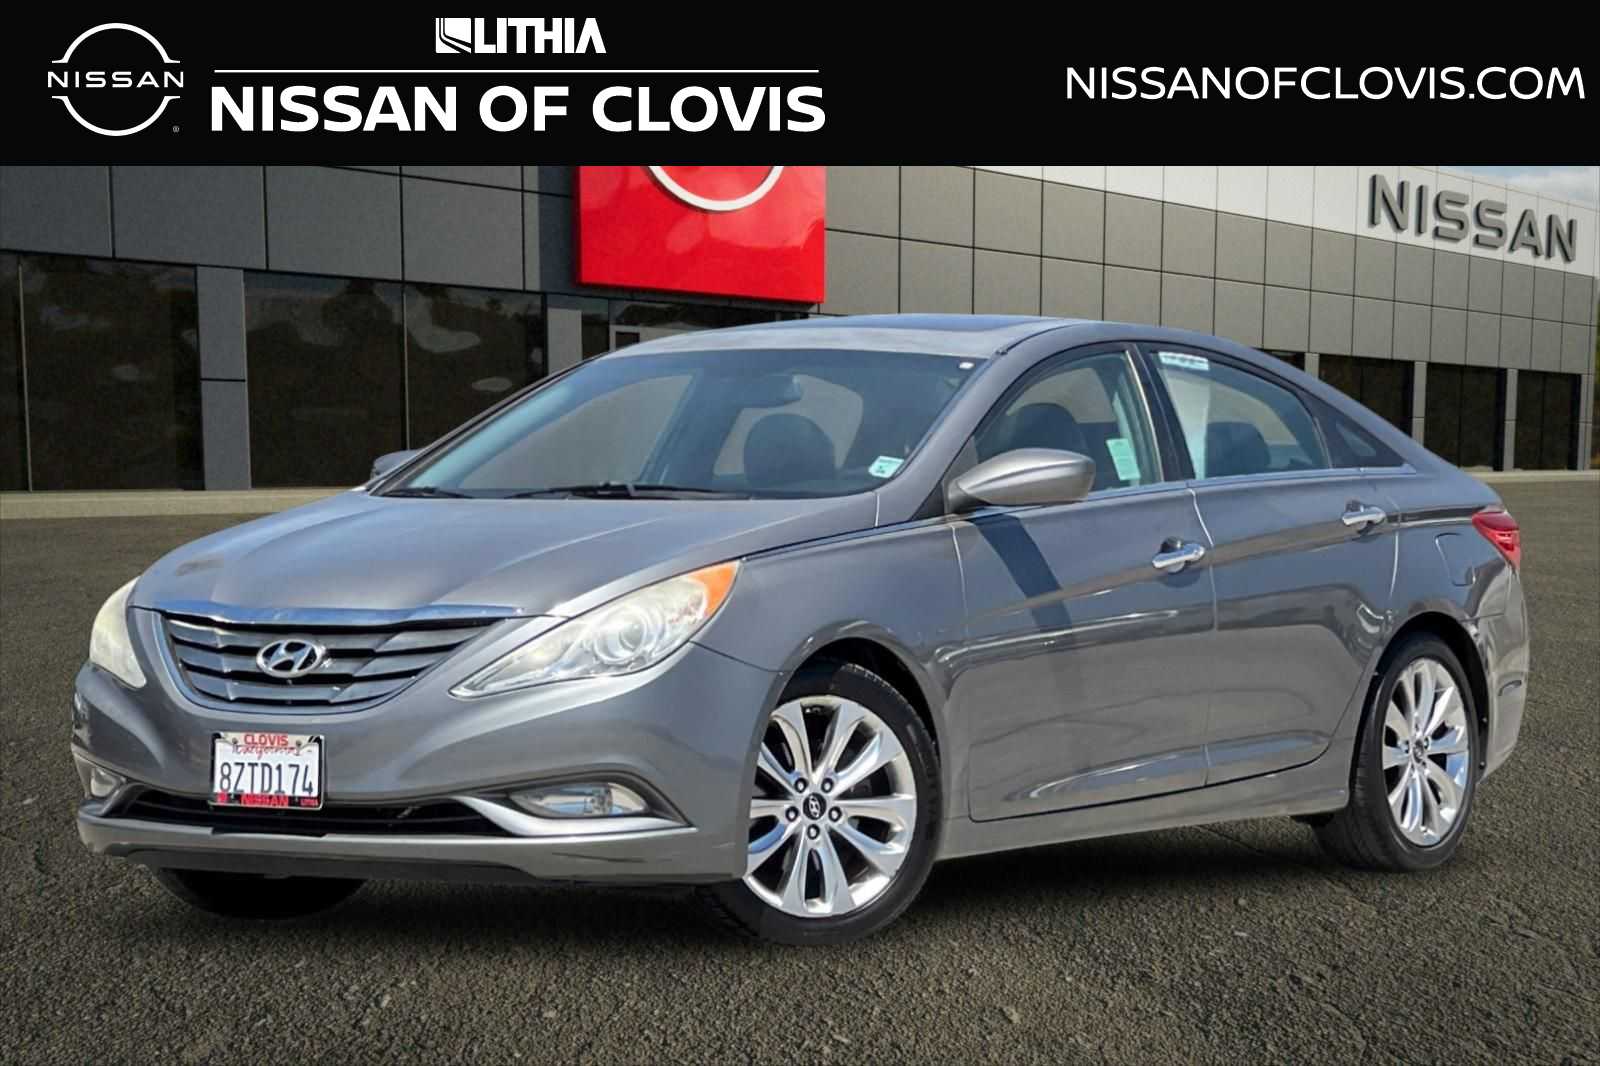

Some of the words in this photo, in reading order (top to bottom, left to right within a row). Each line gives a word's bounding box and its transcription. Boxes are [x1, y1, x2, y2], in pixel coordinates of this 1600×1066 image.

[1368, 173, 1578, 263] NISSAN
[243, 734, 289, 746] CLOVIS
[220, 761, 314, 796] 8ZTD174
